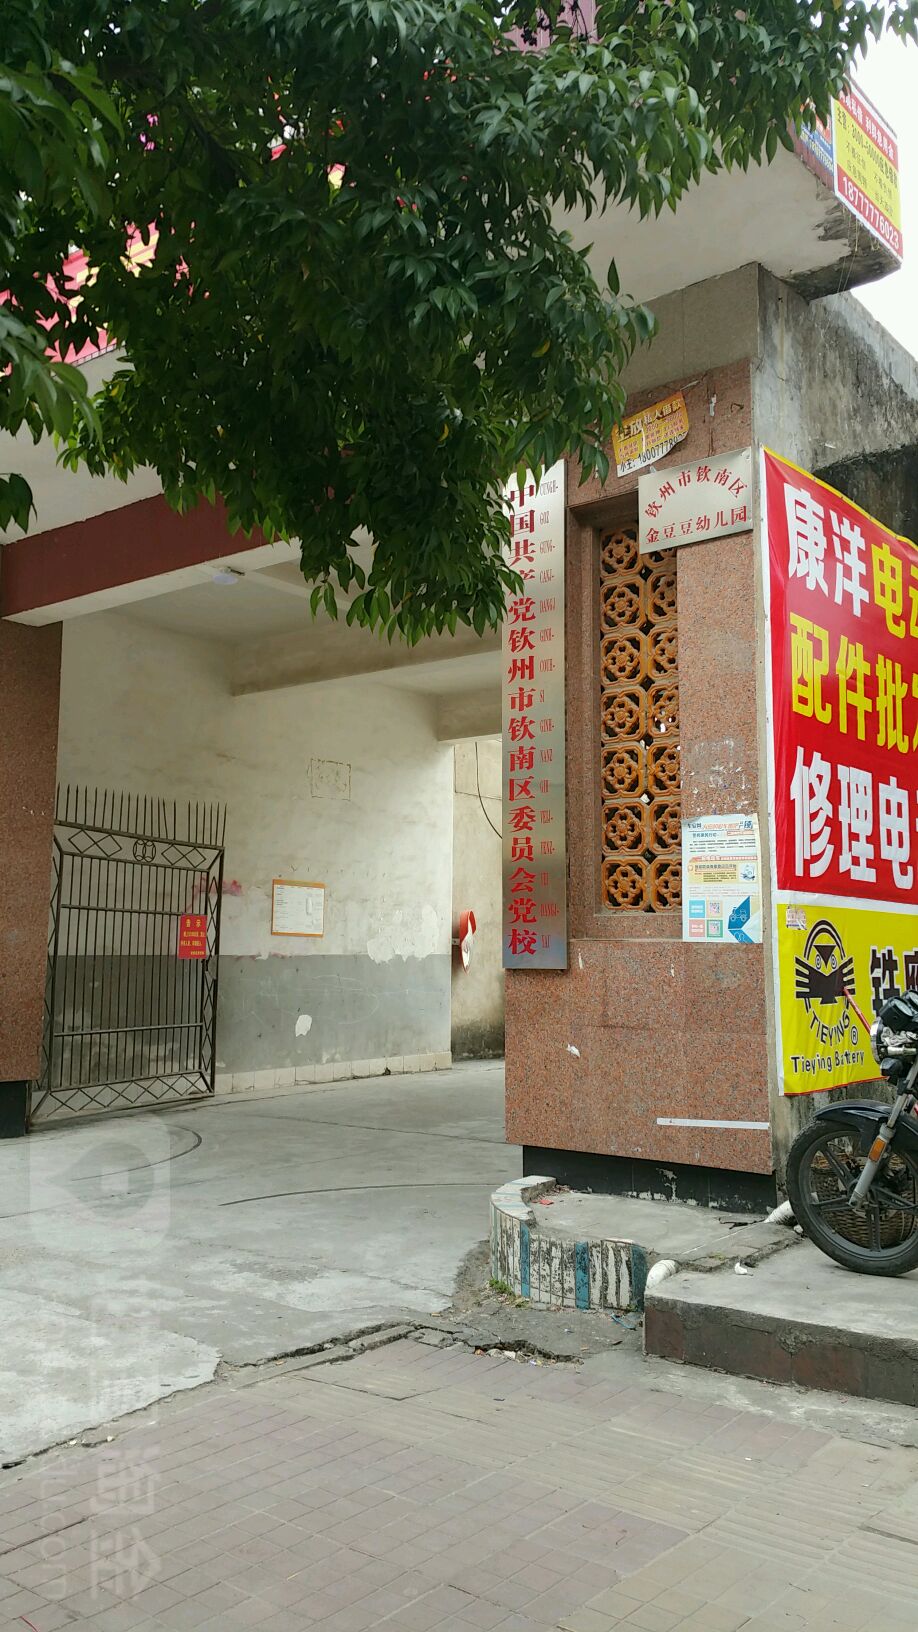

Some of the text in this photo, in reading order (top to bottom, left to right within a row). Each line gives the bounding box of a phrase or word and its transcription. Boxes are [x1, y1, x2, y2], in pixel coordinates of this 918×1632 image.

[842, 176, 900, 249] 18777776023
[644, 465, 749, 519] 钦州市钦南区
[645, 505, 748, 544] 金豆豆幼儿园
[788, 611, 918, 754] 配件批
[789, 745, 918, 890] 修理电
[809, 1010, 850, 1047] TIEYING
[791, 1050, 865, 1075] Tieying Battery
